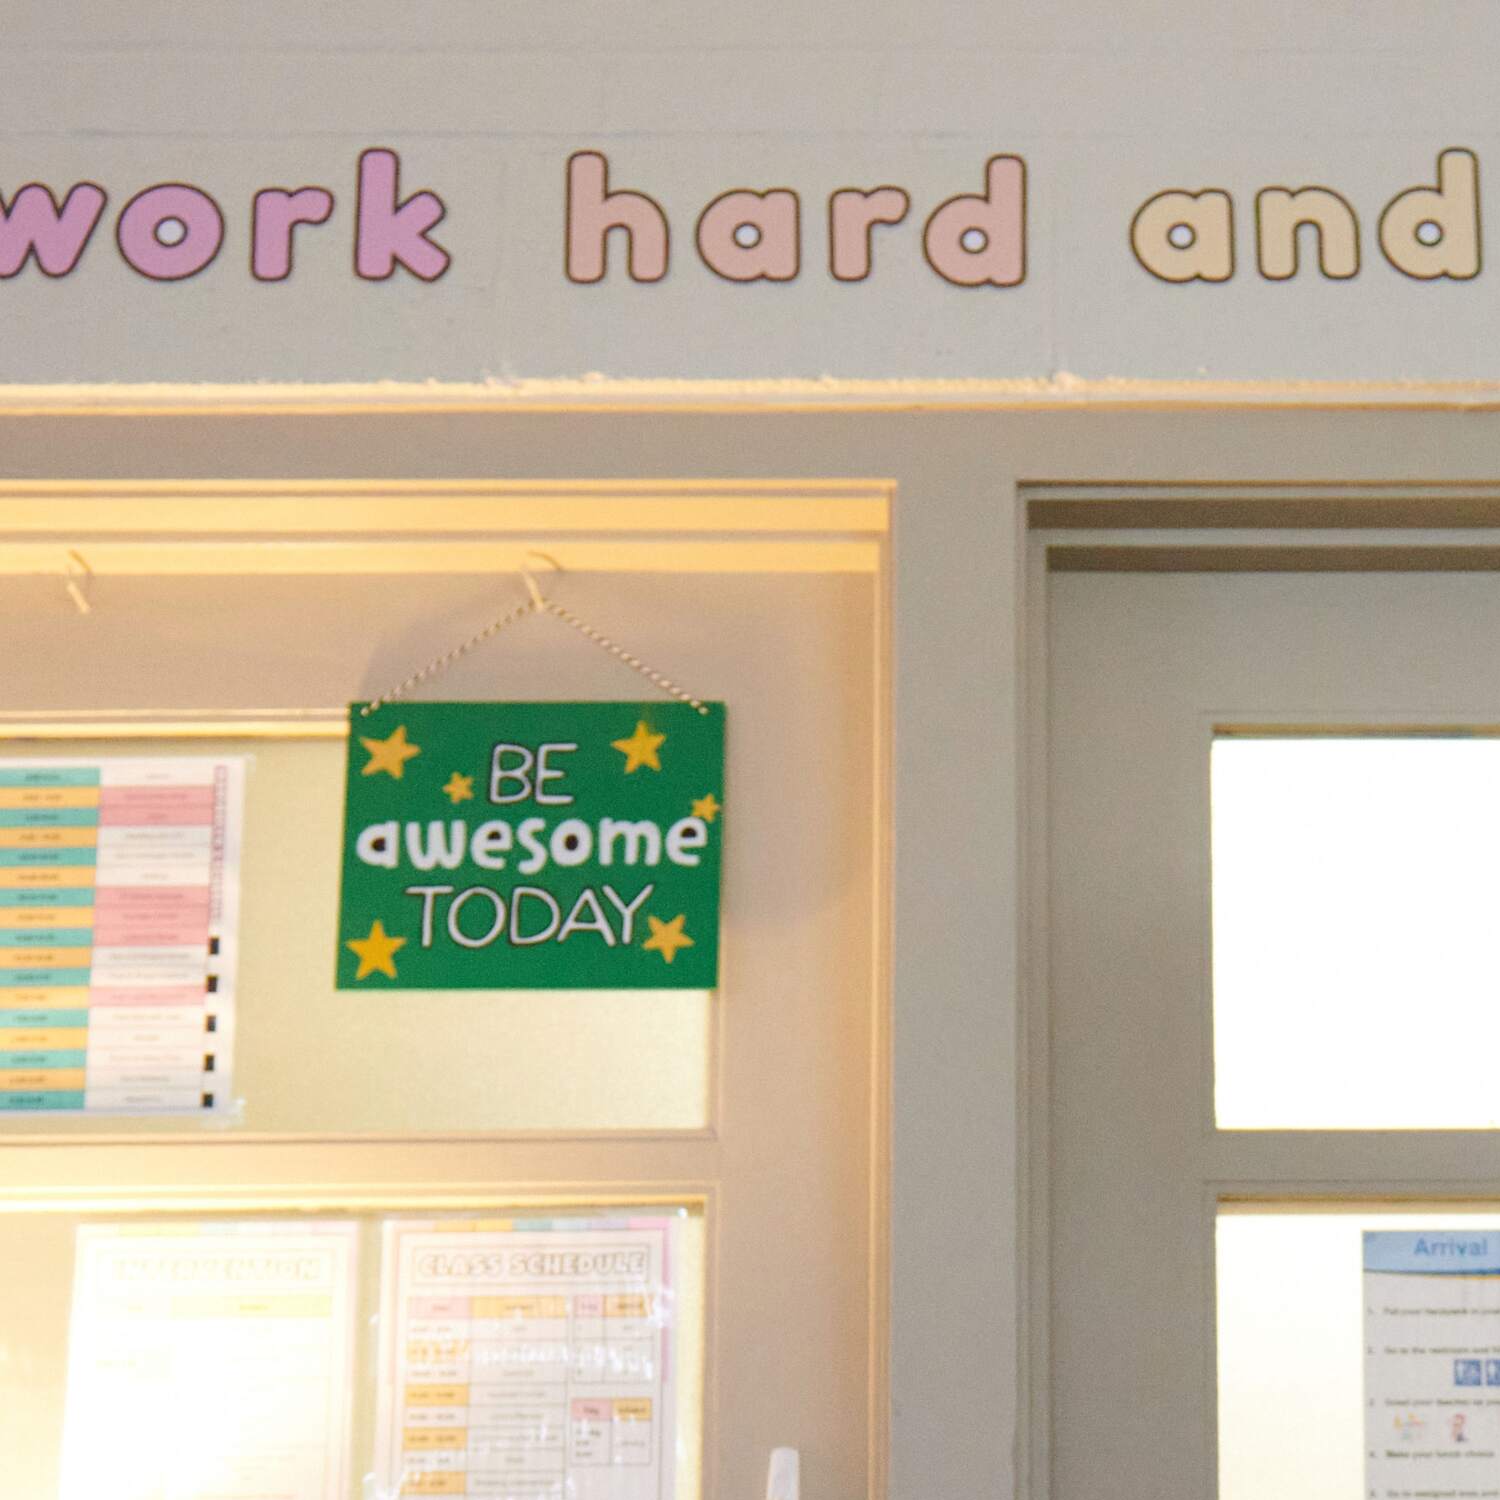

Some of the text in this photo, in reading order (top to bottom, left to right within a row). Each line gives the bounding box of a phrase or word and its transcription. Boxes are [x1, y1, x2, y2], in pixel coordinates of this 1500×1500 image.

[0, 148, 451, 281] work
[565, 150, 1027, 287] hard
[1130, 147, 1482, 283] and
[488, 742, 579, 804] BE
[356, 817, 708, 874] awesome
[404, 884, 655, 948] TODAY
[1413, 1237, 1488, 1256] Arrival
